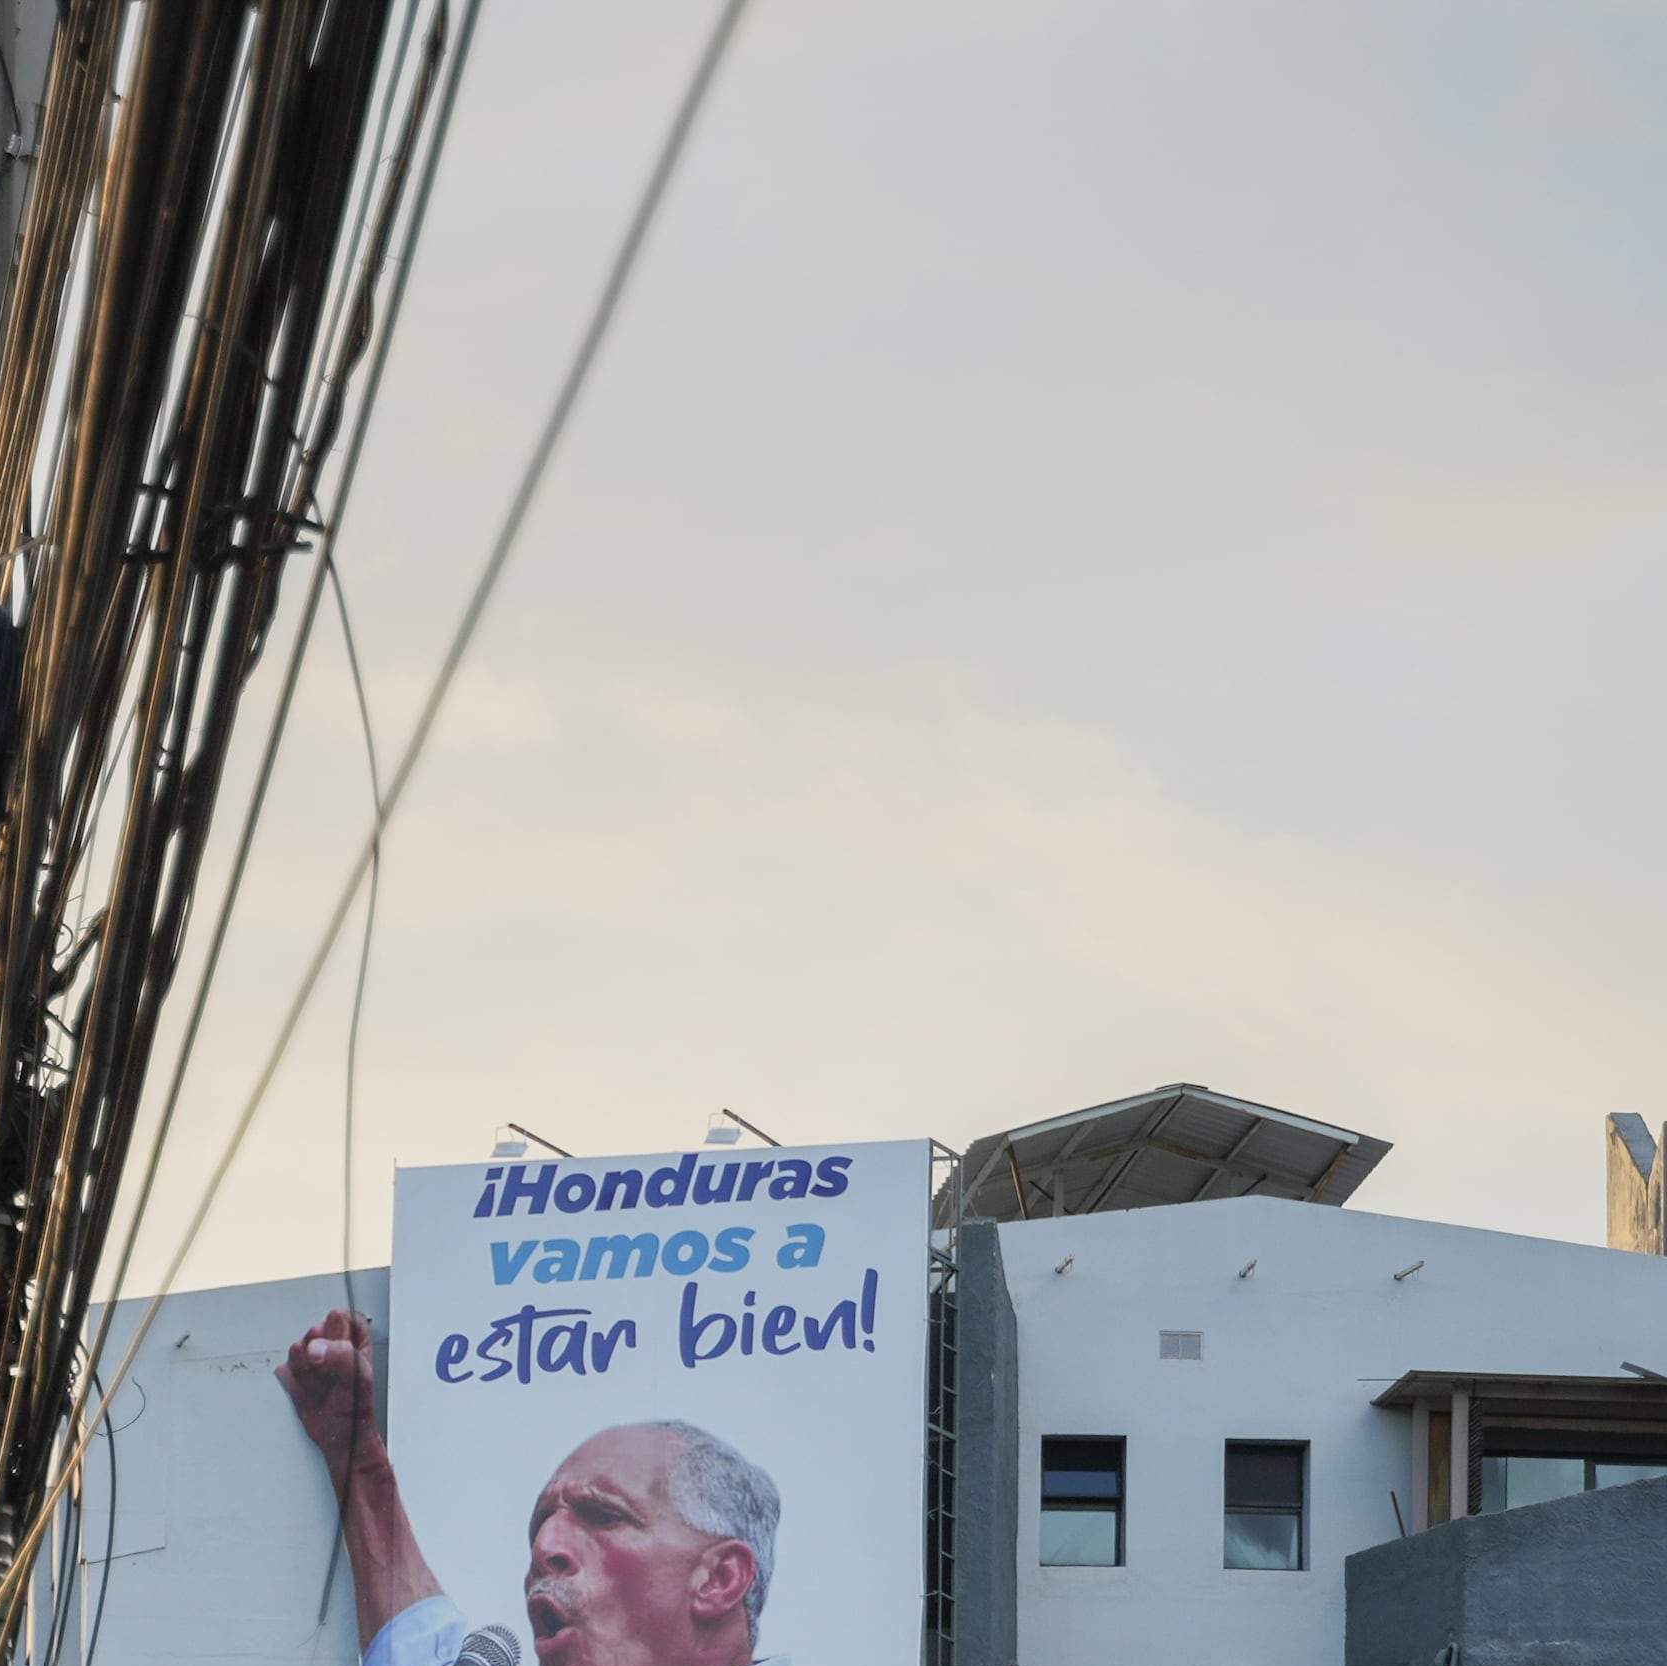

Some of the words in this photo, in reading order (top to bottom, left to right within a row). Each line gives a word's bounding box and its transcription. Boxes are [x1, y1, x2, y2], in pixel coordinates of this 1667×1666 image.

[473, 1153, 854, 1218] ¡Honduras
[490, 1226, 756, 1286] vamos
[775, 1223, 826, 1269] a
[435, 1305, 637, 1385] estar
[678, 1268, 879, 1368] bien!
